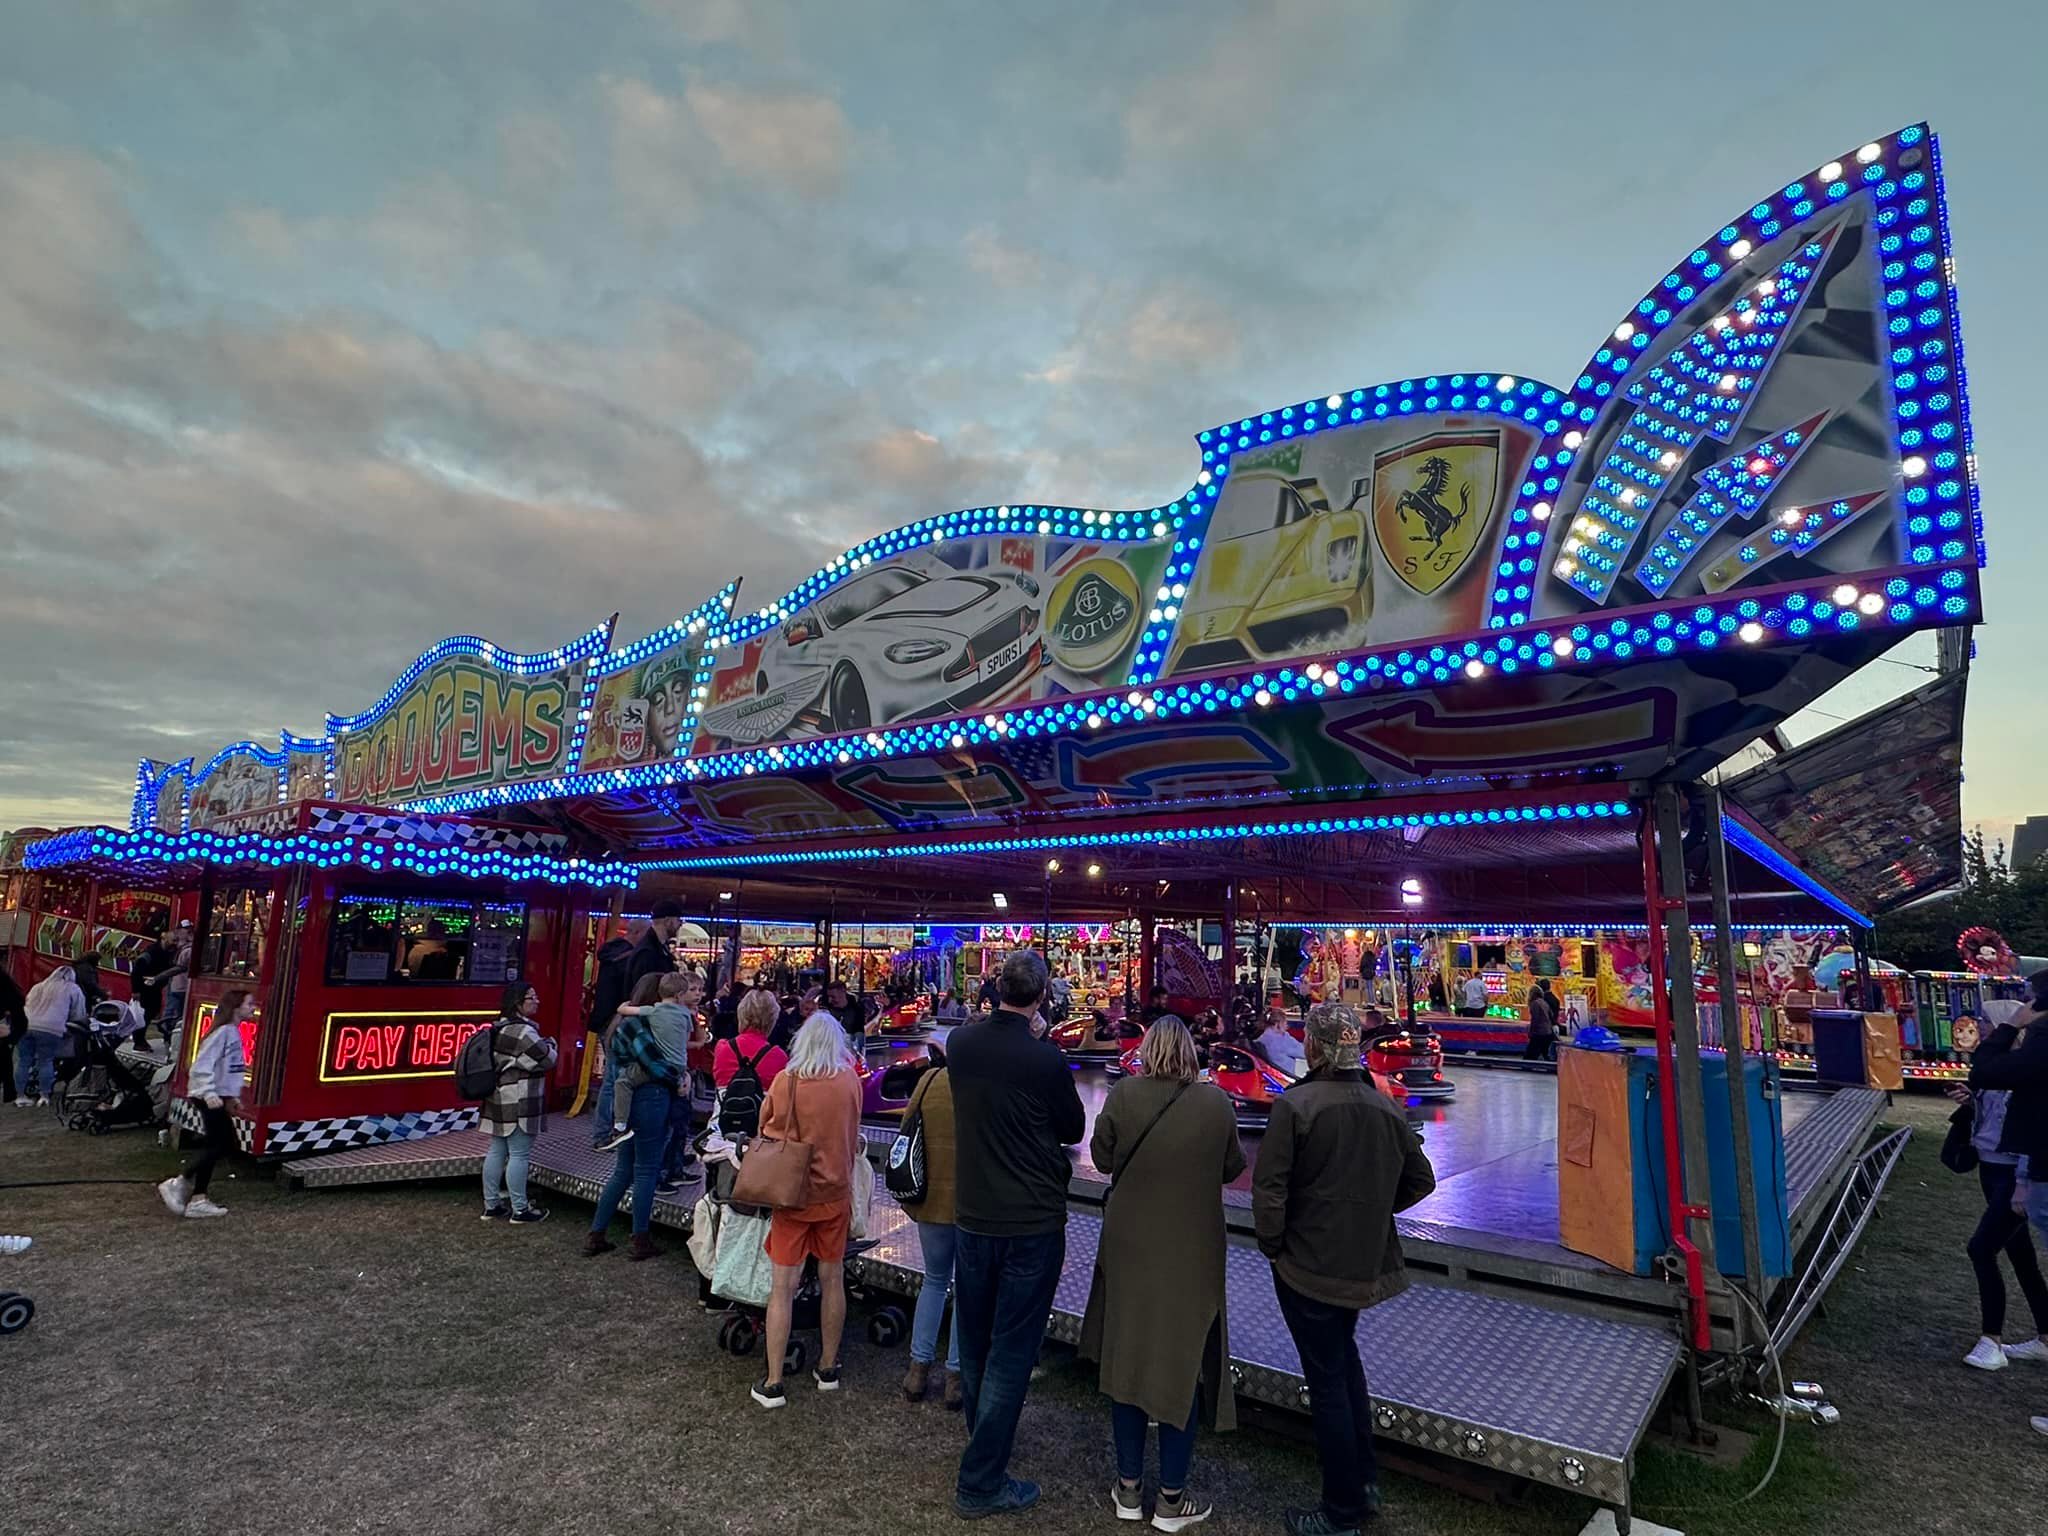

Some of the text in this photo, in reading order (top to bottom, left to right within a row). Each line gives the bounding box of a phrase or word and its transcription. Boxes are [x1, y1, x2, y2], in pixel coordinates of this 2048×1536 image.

[1403, 557, 1418, 574] S
[1060, 601, 1126, 641] LOTUS
[342, 667, 563, 801] DODGEMS
[335, 1023, 492, 1070] PAY HER
